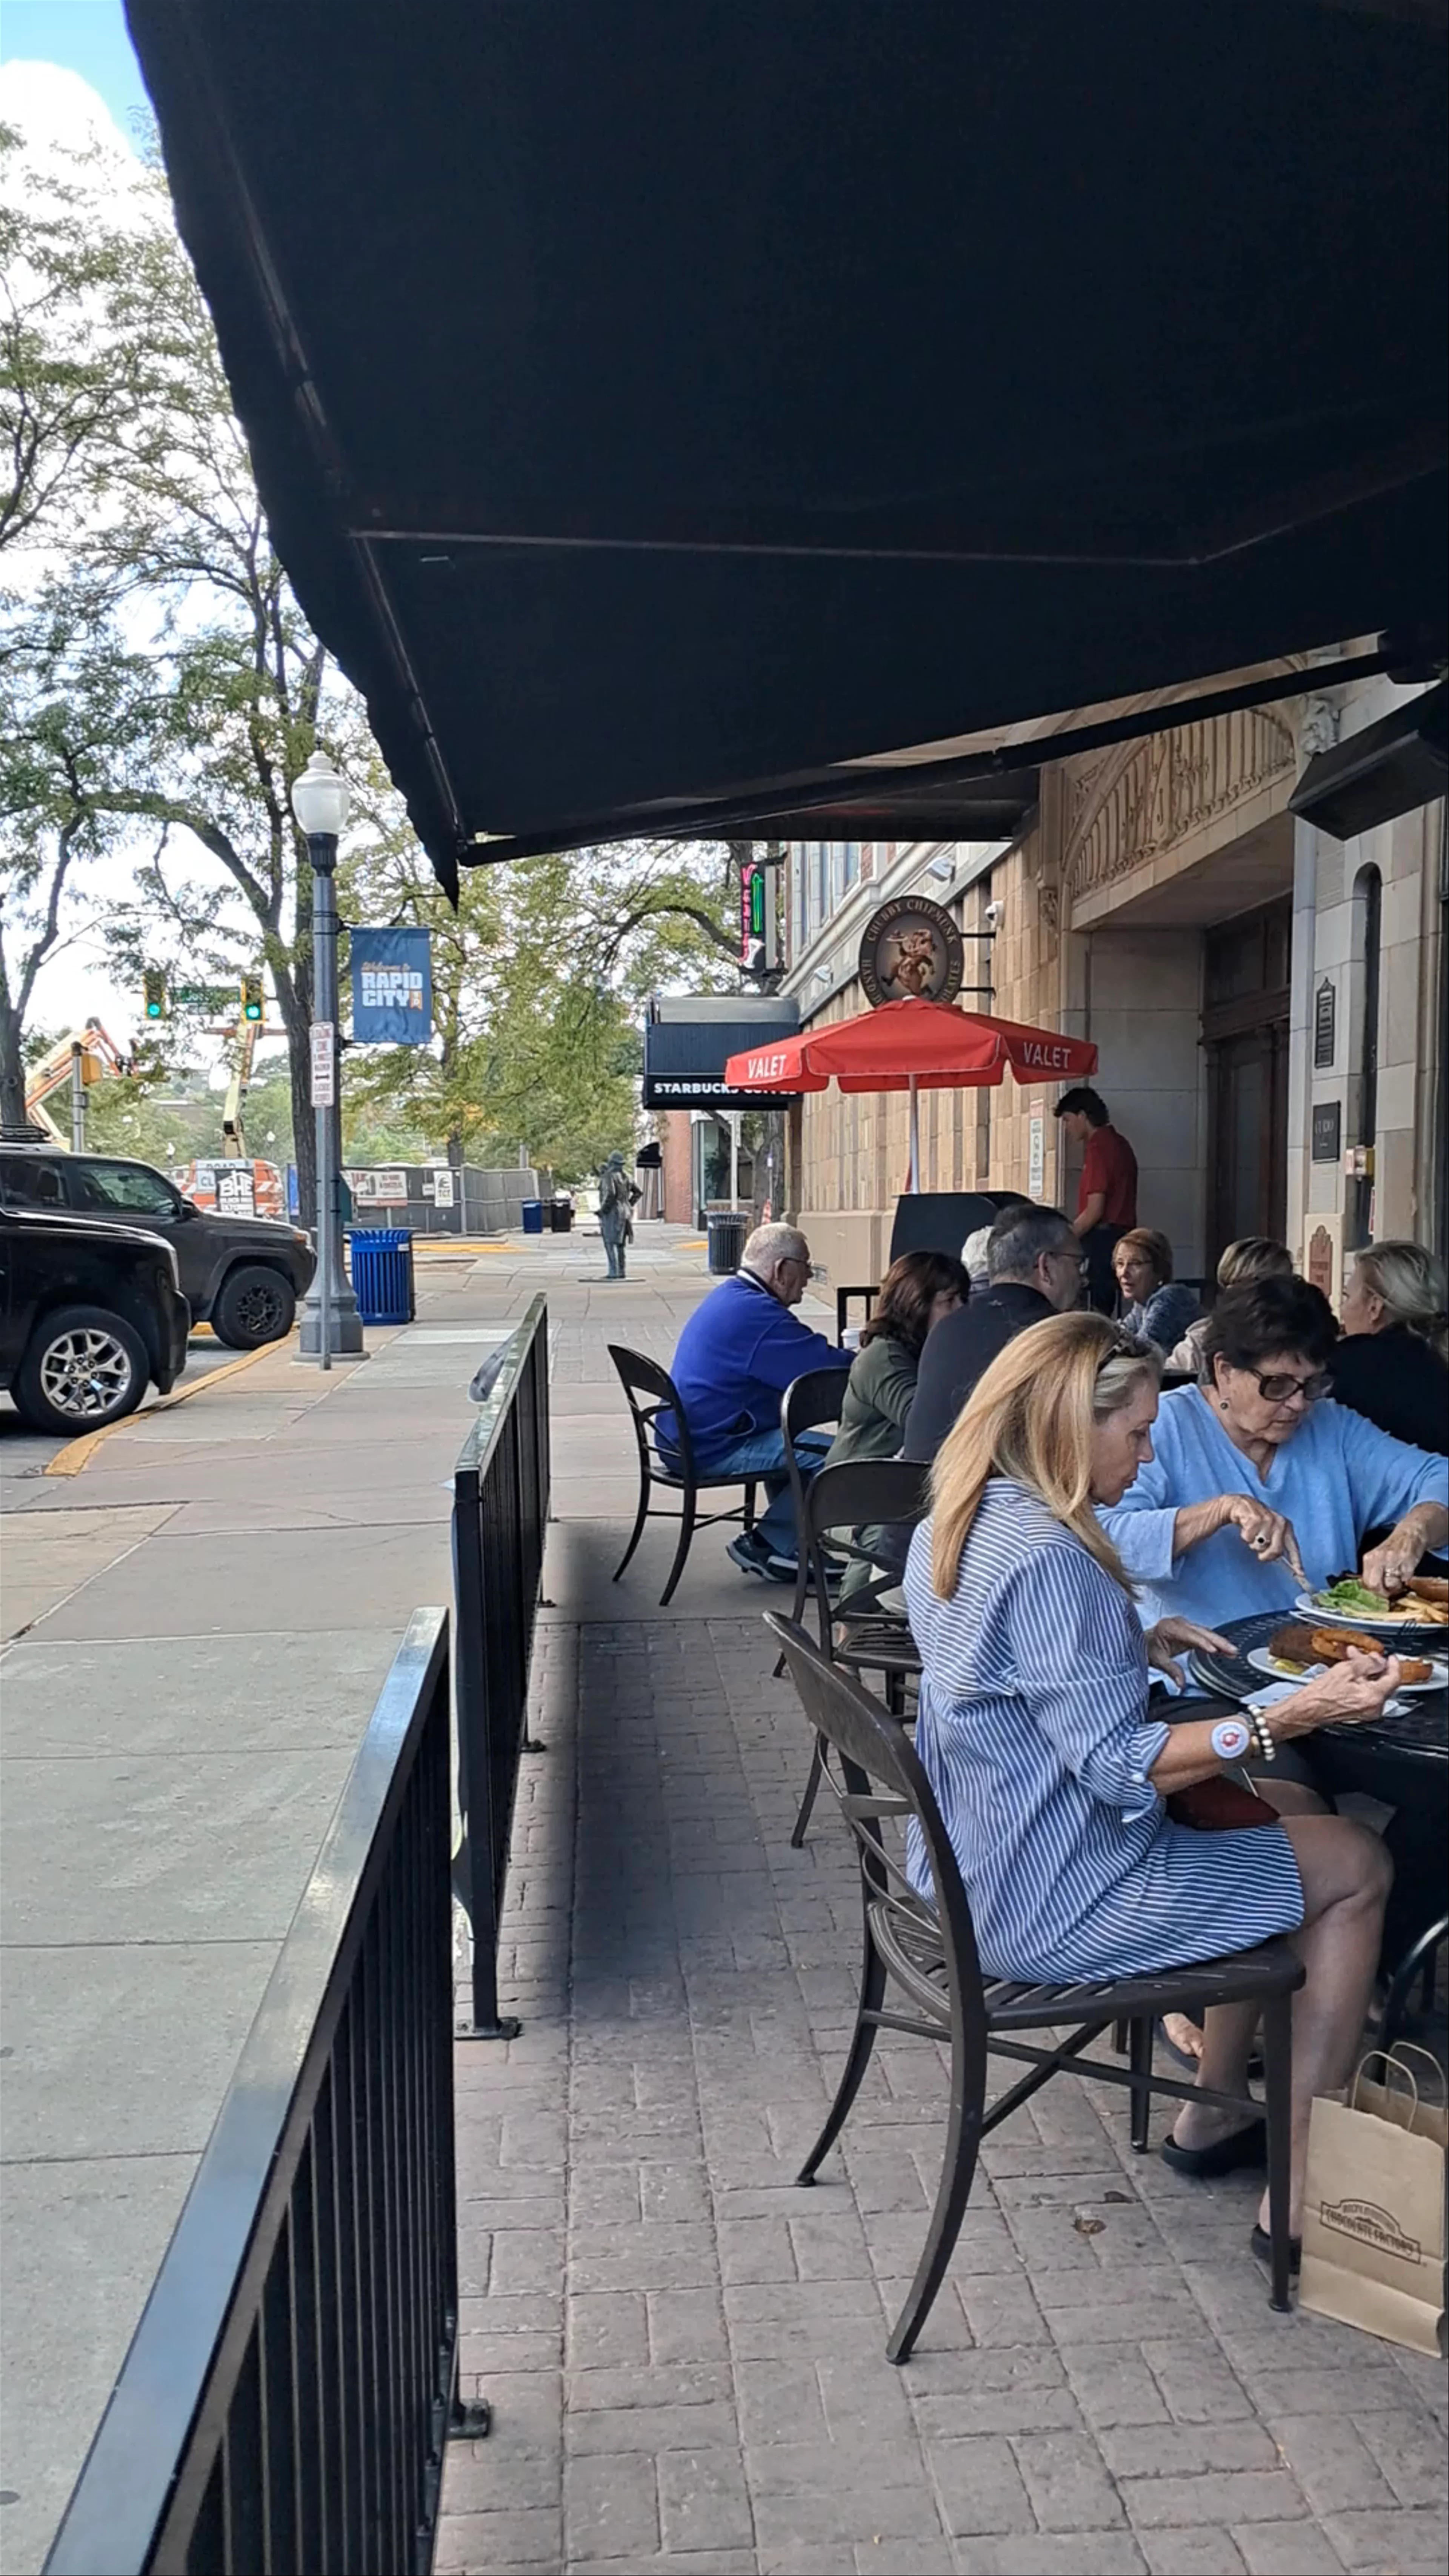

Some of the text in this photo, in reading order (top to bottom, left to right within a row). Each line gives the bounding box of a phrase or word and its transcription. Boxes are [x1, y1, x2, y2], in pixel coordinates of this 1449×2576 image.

[867, 900, 958, 944] CHUBBY CHIPMUNK
[361, 972, 423, 989] RAPID
[362, 990, 409, 1007] CITY
[748, 1055, 786, 1079] VALET
[1023, 1042, 1072, 1069] VALET
[218, 1170, 254, 1196] BHE
